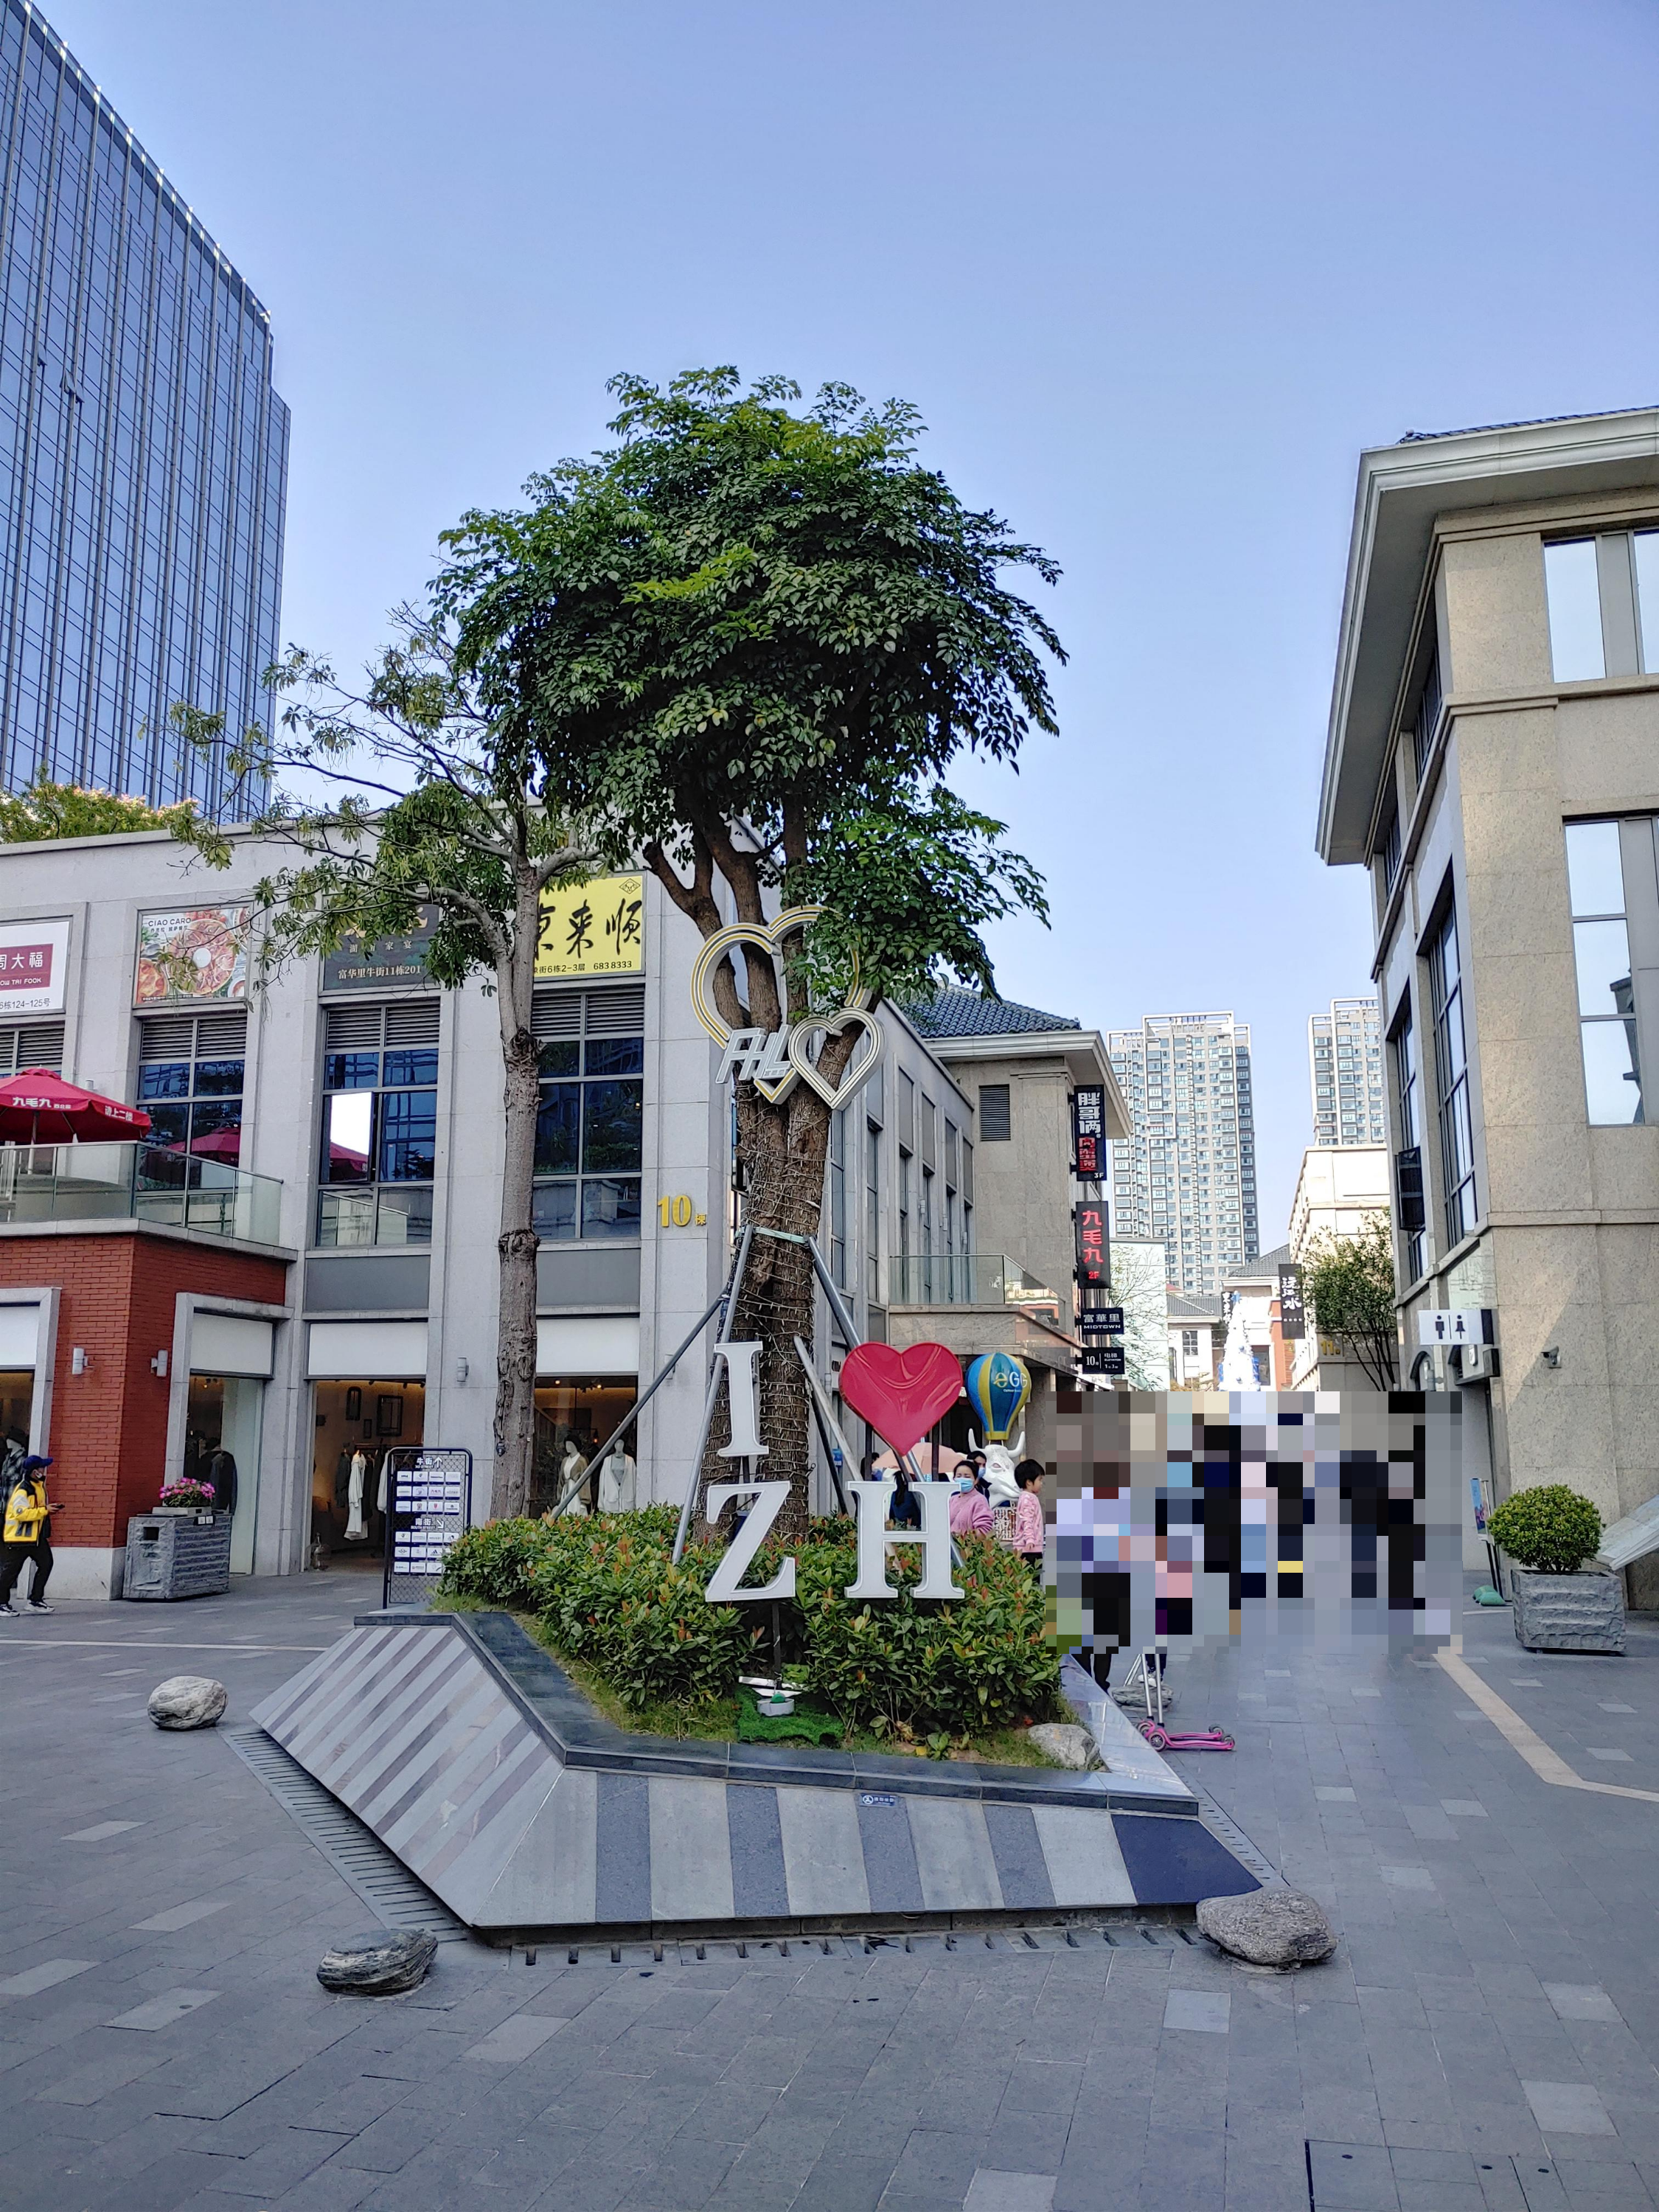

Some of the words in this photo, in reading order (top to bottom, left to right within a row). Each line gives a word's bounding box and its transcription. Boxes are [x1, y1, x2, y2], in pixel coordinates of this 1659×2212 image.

[715, 1025, 793, 1084] FHL
[13, 1097, 52, 1107] 九毛九
[1082, 1210, 1104, 1264] 九毛九
[1088, 1270, 1100, 1279] 2F
[714, 1341, 769, 1457] I
[417, 1457, 433, 1465] 牛街
